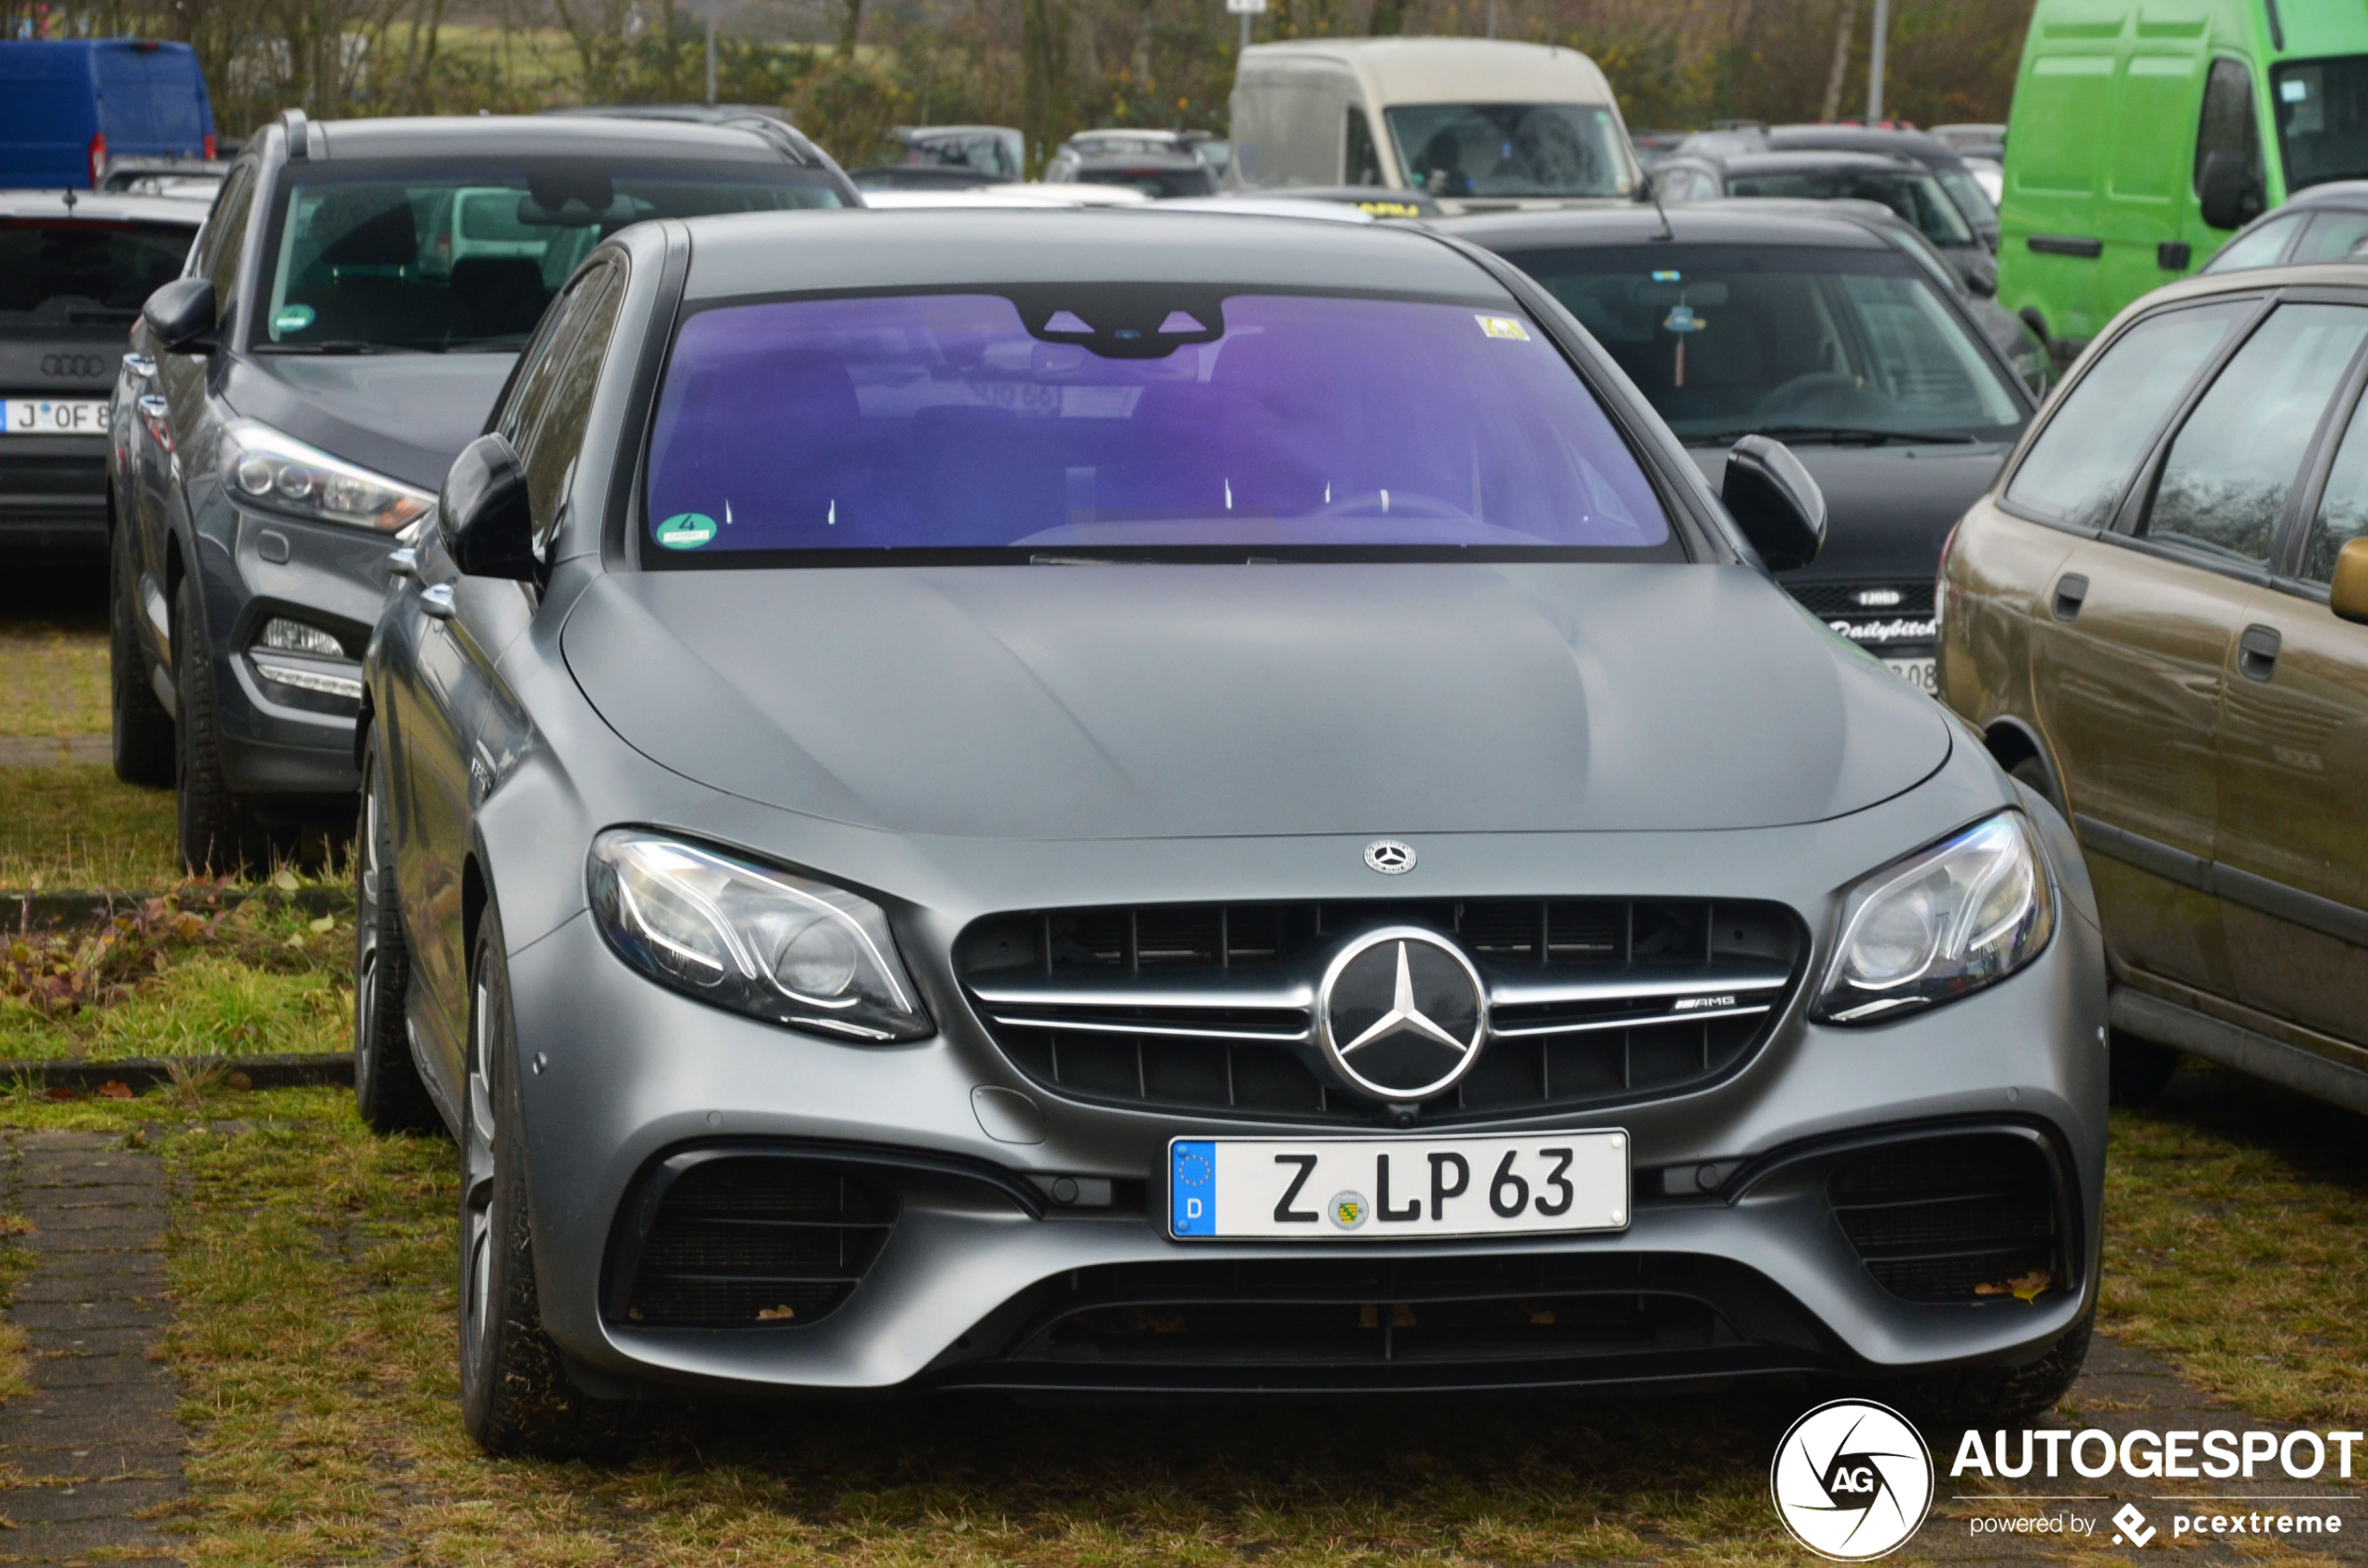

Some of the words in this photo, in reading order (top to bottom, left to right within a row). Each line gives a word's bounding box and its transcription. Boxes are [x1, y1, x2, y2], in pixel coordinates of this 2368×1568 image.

[20, 405, 35, 428] J
[56, 405, 89, 428] OF
[679, 514, 696, 530] 4
[1695, 996, 1735, 1007] AMG
[1273, 1154, 1319, 1222] Z
[1376, 1152, 1470, 1222] LP
[1489, 1148, 1574, 1218] 63
[1187, 1198, 1203, 1218] D
